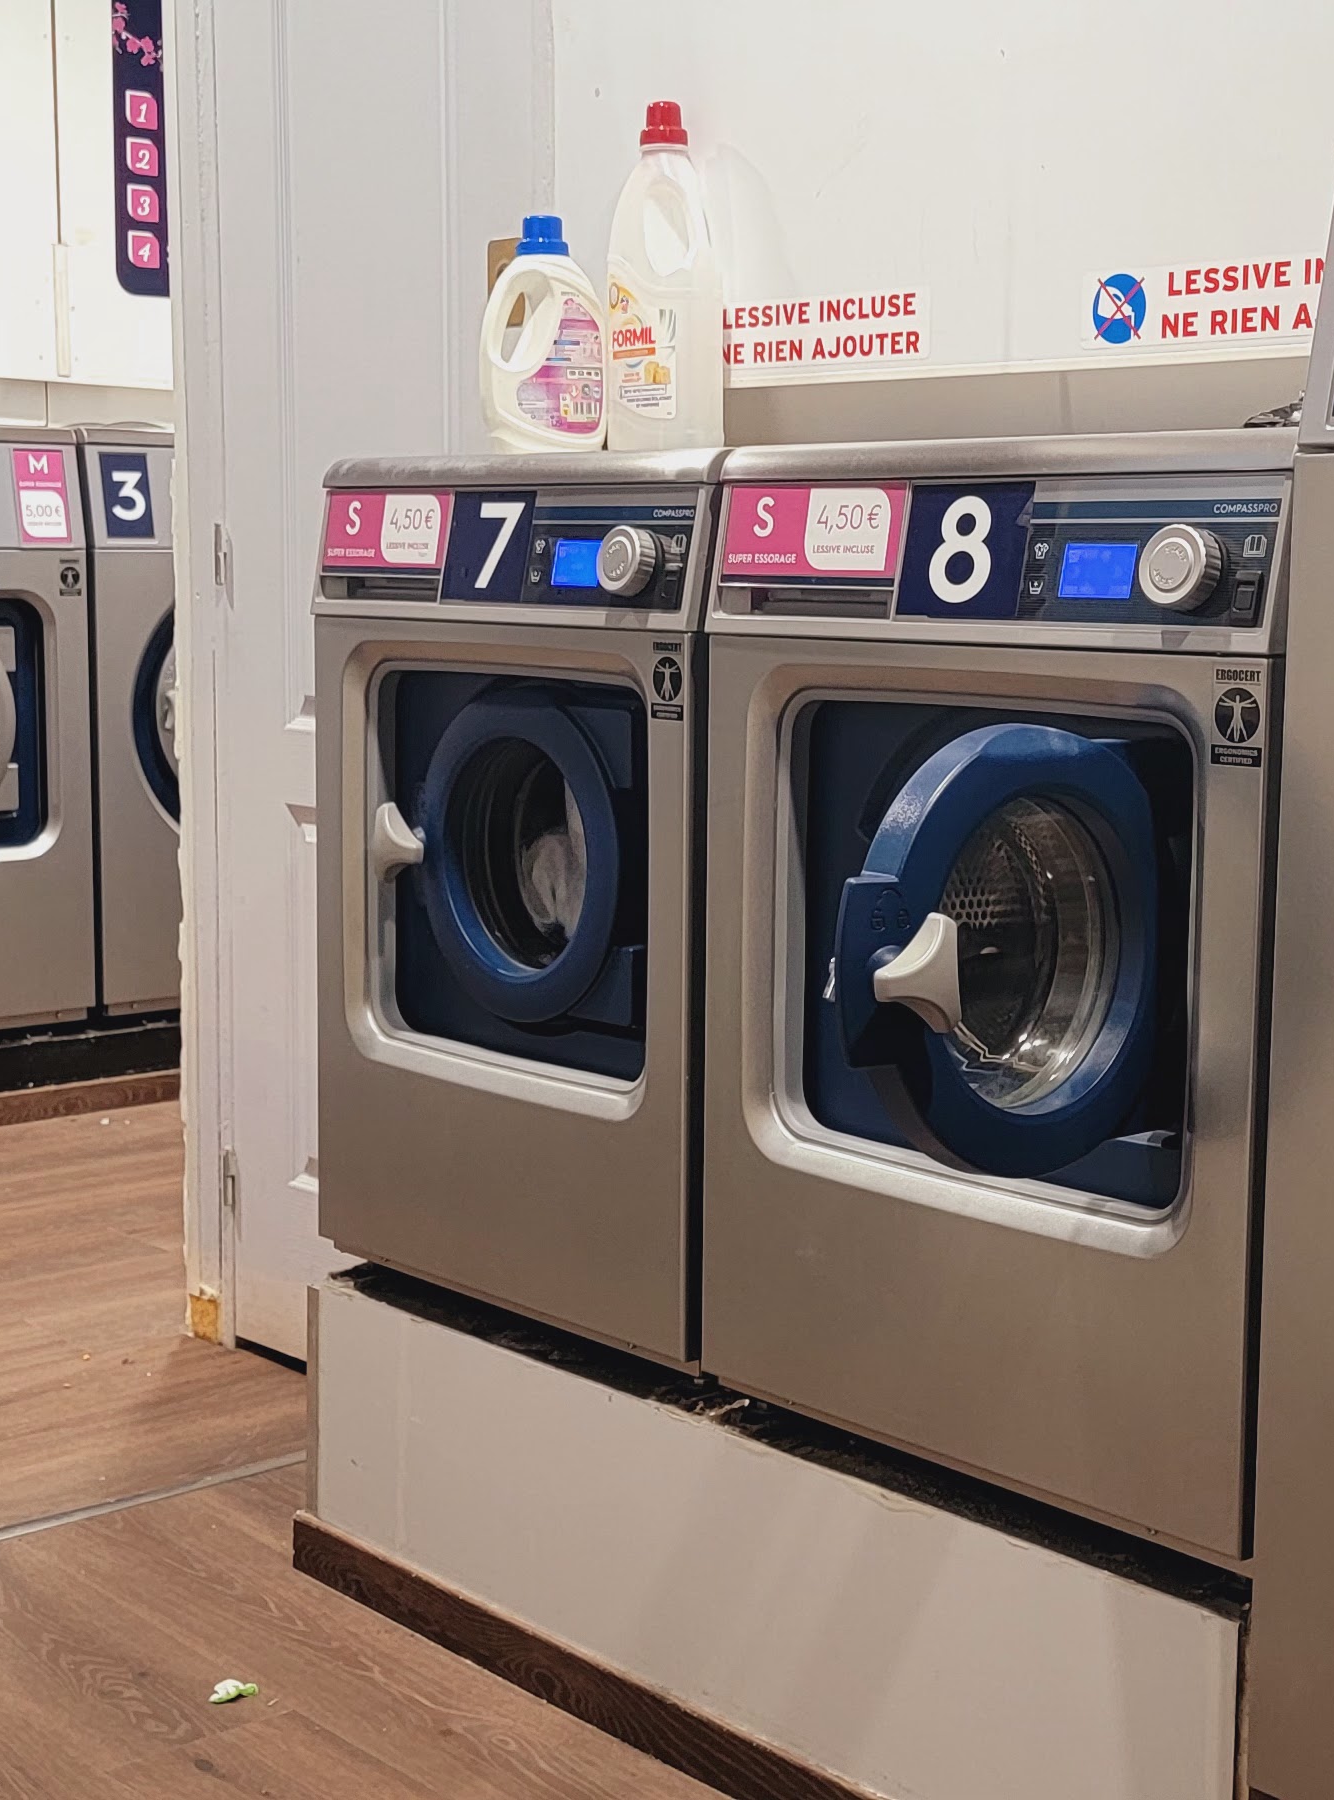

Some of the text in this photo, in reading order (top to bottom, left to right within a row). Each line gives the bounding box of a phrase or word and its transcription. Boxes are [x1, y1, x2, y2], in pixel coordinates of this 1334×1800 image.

[137, 103, 147, 122] 1
[138, 150, 150, 169] 2
[138, 197, 150, 215] 3
[138, 242, 151, 262] 4
[1168, 261, 1291, 297] LESSIVE
[723, 293, 916, 330] LESSIVE INCLUSE
[1162, 312, 1198, 339] NE
[1210, 305, 1280, 335] RIEN
[612, 326, 656, 350] FORMIL
[753, 339, 803, 364] RIEN
[812, 331, 919, 360] AJOUTER
[28, 453, 48, 474] M
[111, 470, 146, 521] 3
[26, 504, 52, 518] 5,00
[346, 500, 362, 535] S
[653, 508, 695, 518] COMPASSPRO
[753, 496, 775, 538] S
[1213, 503, 1278, 514] COMPASSPRO
[474, 502, 526, 589] 7
[813, 544, 875, 554] LESSIVE INCLUSE
[929, 495, 992, 604] 8
[728, 553, 797, 564] SUPER ESSORAGE
[1216, 668, 1261, 682] ERGOCERT
